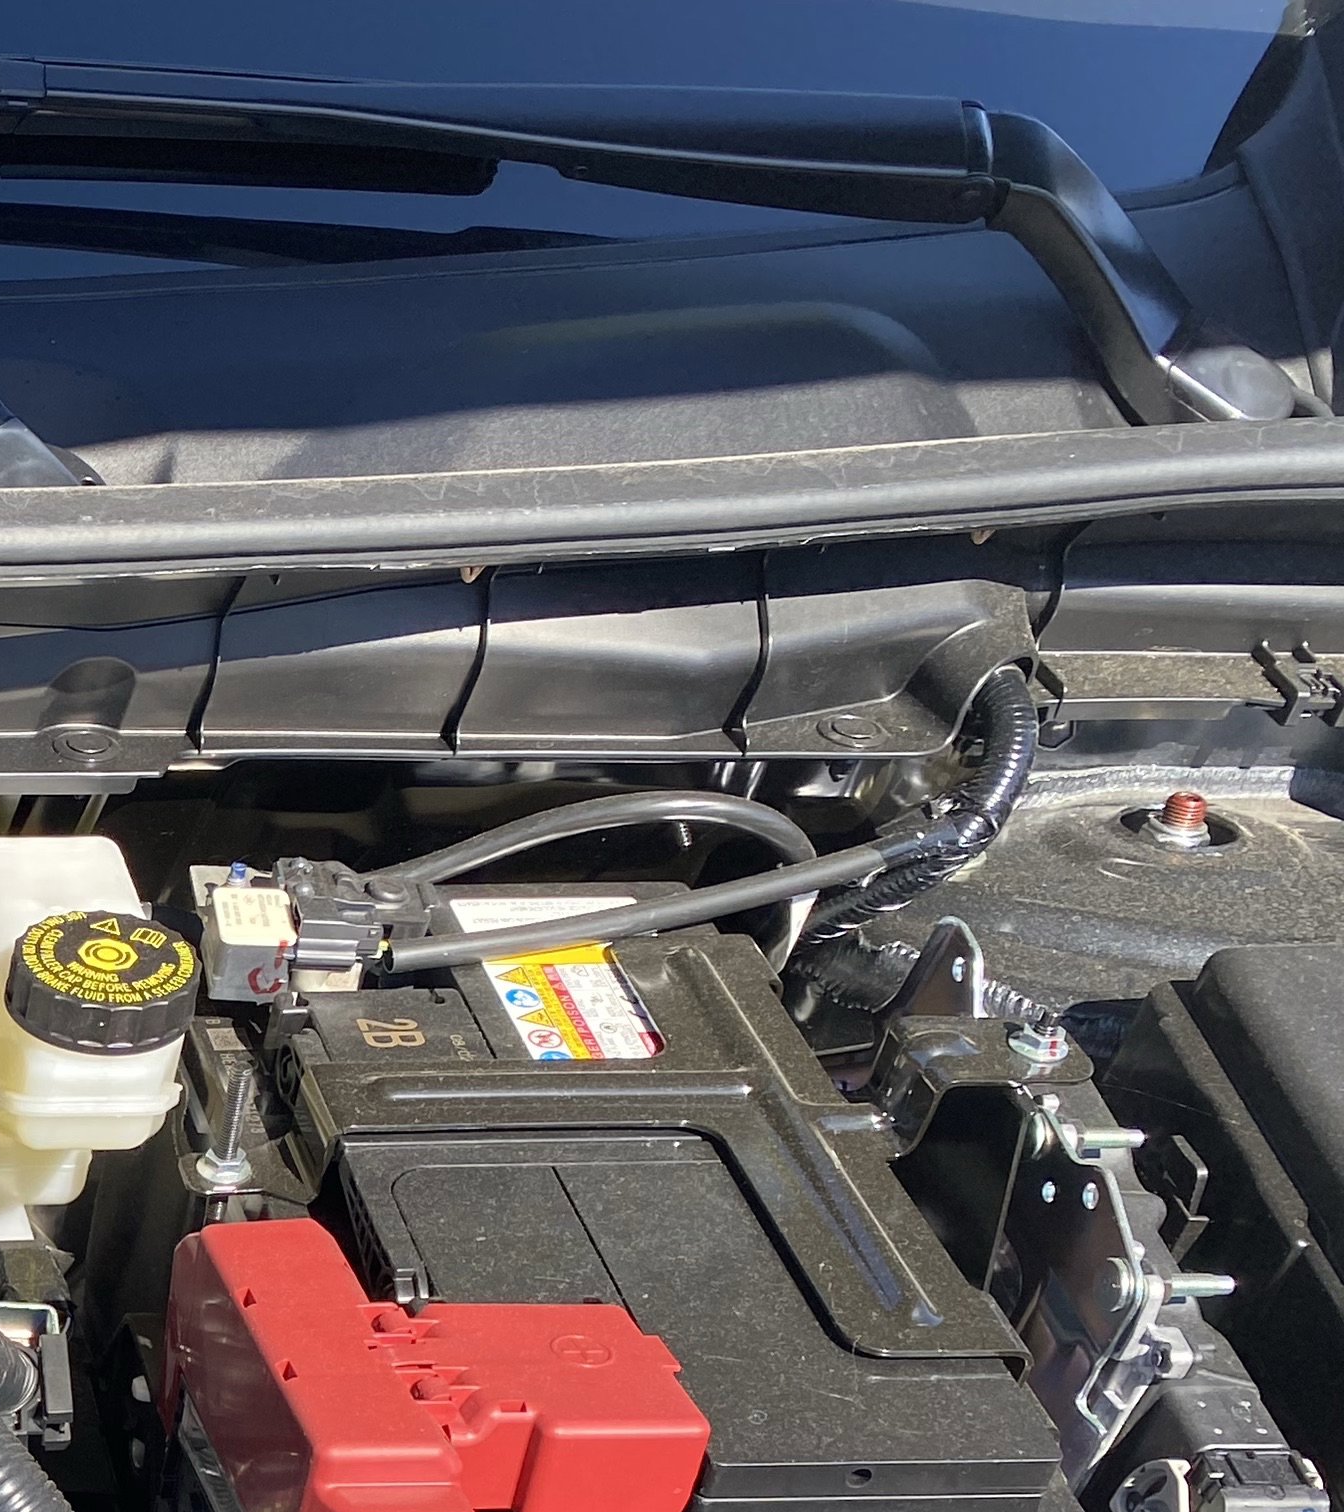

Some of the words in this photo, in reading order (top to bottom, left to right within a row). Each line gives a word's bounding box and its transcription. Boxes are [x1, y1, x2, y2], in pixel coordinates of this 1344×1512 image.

[36, 971, 71, 992] BRAKE
[70, 988, 105, 1001] FLUID
[109, 992, 142, 1002] FROM
[144, 991, 152, 1000] A
[152, 976, 186, 997] SEALED
[40, 950, 63, 973] FILLER
[59, 971, 82, 983] CAP
[82, 979, 132, 992] BEFORE
[132, 963, 176, 990] REMOVING
[67, 961, 119, 982] WARNING
[356, 1017, 426, 1048] 2B
